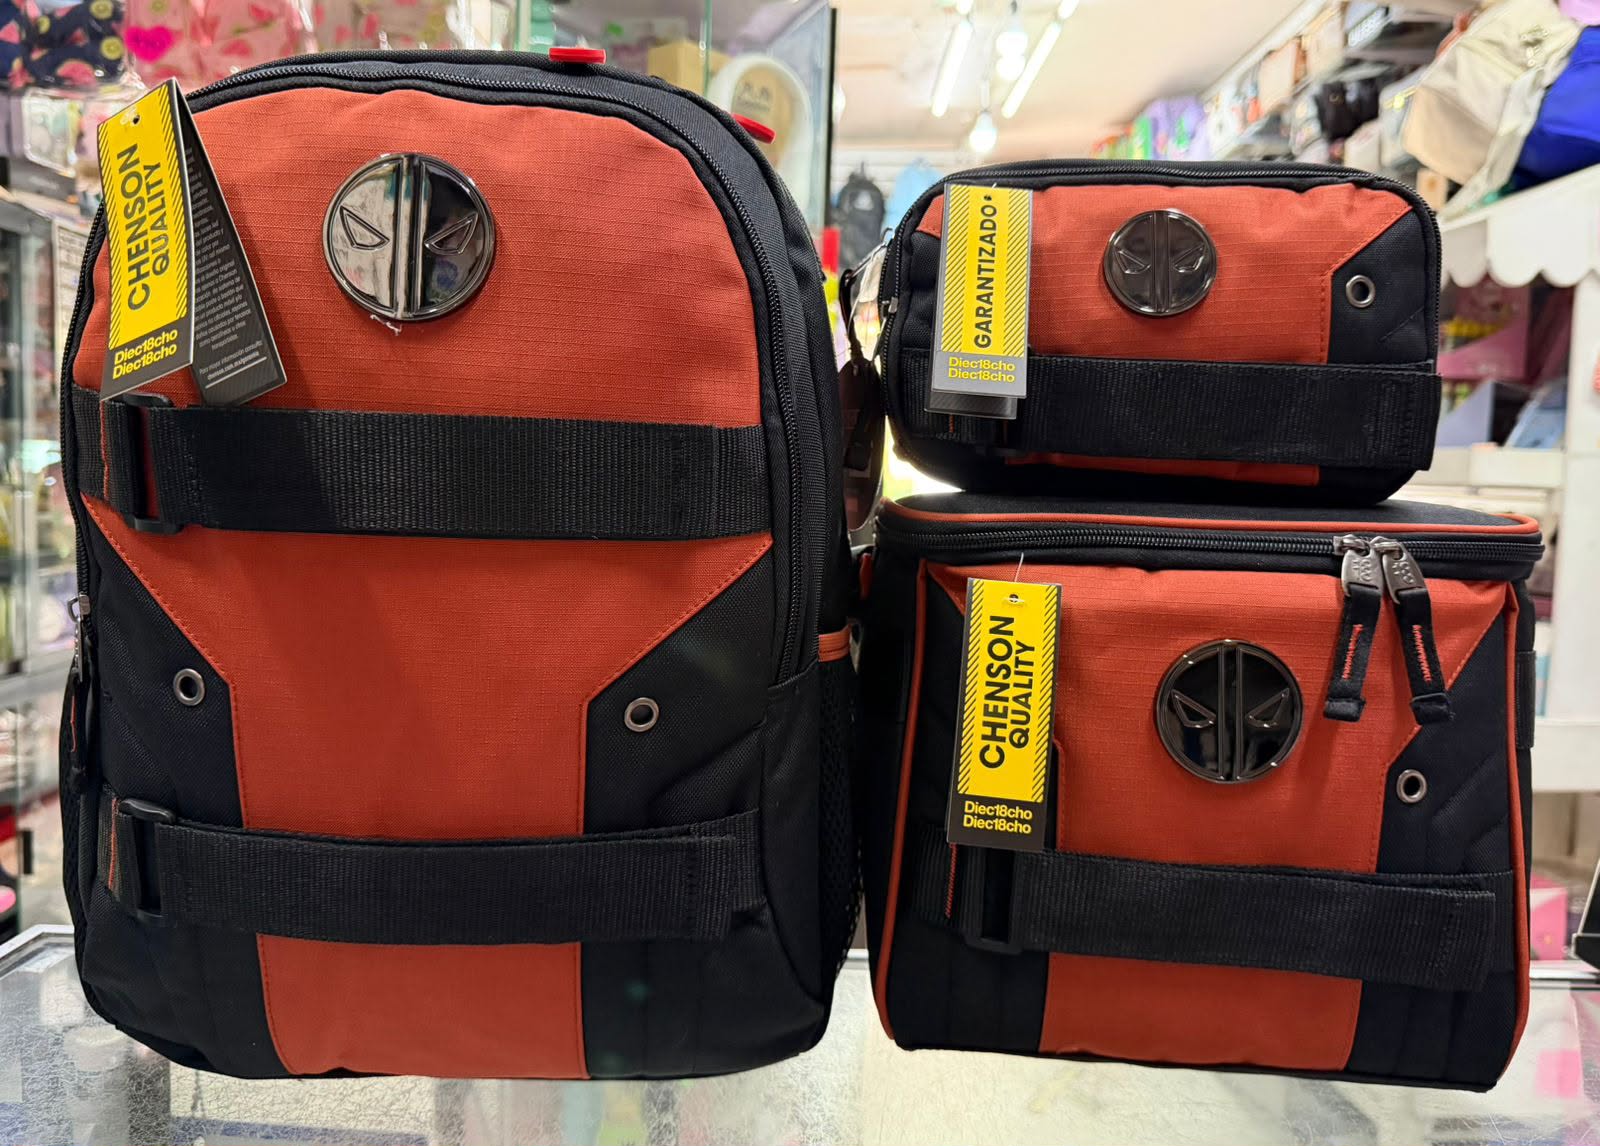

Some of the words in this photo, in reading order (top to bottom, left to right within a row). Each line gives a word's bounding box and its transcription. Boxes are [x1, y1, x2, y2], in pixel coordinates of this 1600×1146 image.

[117, 143, 151, 310] CHENSON
[143, 162, 170, 276] QUALITY
[973, 204, 998, 349] GARANTIZADO
[112, 343, 177, 379] Diec18cho
[114, 329, 178, 365] Diec18cho
[949, 356, 1016, 372] Diec18cho
[948, 367, 1015, 383] Diec18cho
[979, 615, 1015, 768] CHENSON
[1009, 640, 1036, 749] QUALITY
[963, 814, 1032, 836] Diec18cho
[964, 800, 1033, 821] Diec18cho
